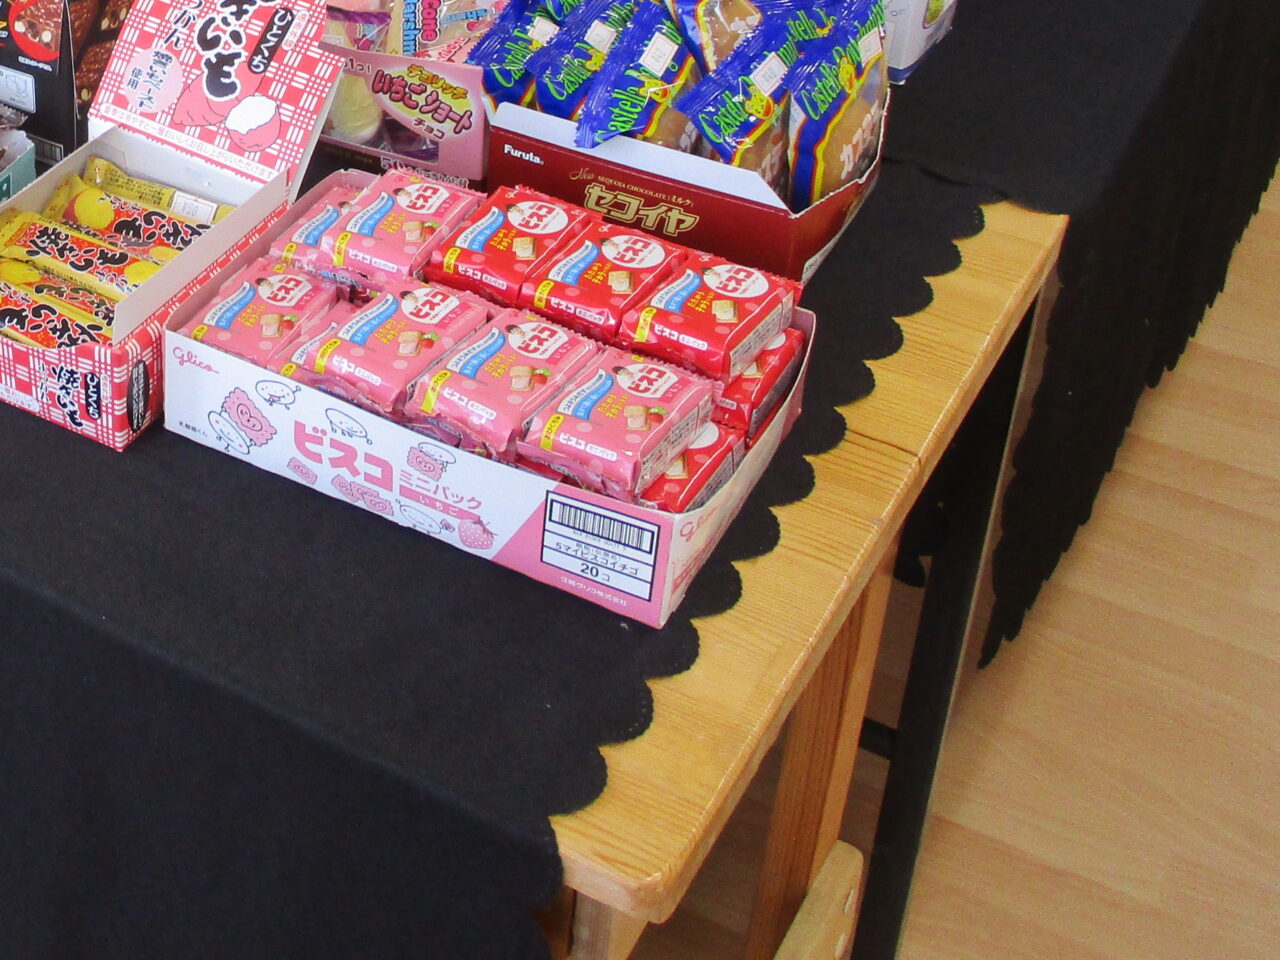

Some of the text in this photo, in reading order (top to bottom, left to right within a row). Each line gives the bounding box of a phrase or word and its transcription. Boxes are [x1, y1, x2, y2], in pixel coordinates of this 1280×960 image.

[250, 6, 294, 73] ひとくち
[126, 67, 143, 90] 使用
[344, 57, 373, 74] 1つ!
[406, 63, 470, 100] デコリッチ
[371, 69, 473, 134] いちごショート
[413, 116, 446, 141] チョコ
[503, 144, 541, 164] Furuta
[597, 175, 626, 189] SEQUOIA
[407, 185, 441, 211] ビスコ
[583, 182, 700, 237] セコイヤ
[517, 203, 557, 230] ビスコ
[25, 226, 130, 273] 焼きいも
[348, 249, 371, 265] ビスコ
[612, 237, 653, 263] ビスコ
[457, 263, 482, 281] ビスコ
[714, 265, 756, 294] ビスコ
[266, 277, 303, 303] ビスコ
[409, 290, 451, 320] ビスコ
[549, 296, 576, 314] ビスコ
[517, 325, 559, 355] ビスコ
[654, 323, 680, 341] ビスコ
[172, 347, 220, 374] Glico
[627, 367, 667, 394] ビスコ
[442, 386, 467, 407] ビスコ
[558, 431, 586, 450] ビスコ
[294, 420, 394, 493] ビスコ
[399, 469, 483, 510] ミニパック
[419, 495, 460, 515] いちご
[555, 541, 640, 576] 5マイビスコイチゴ
